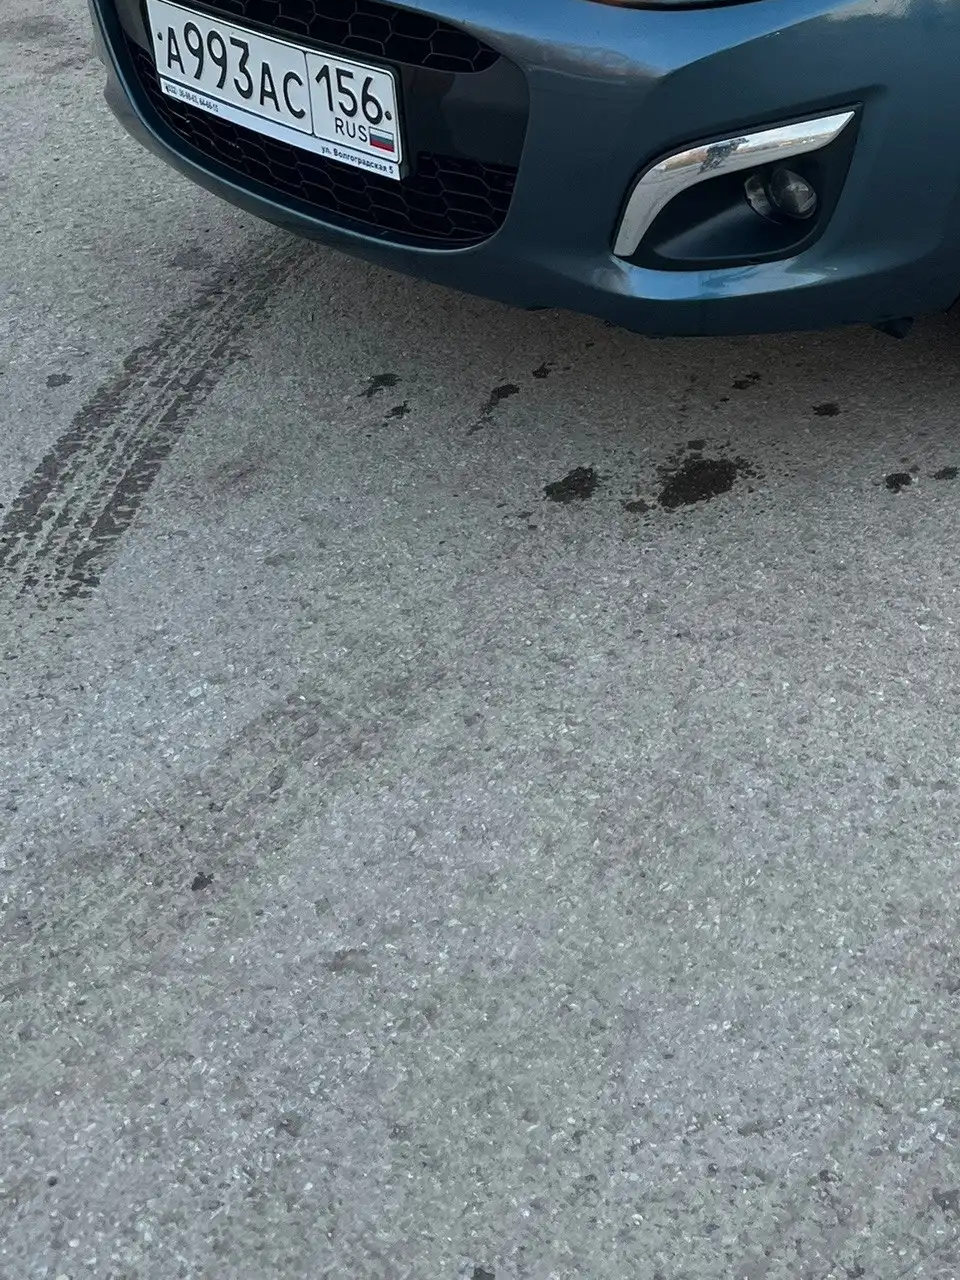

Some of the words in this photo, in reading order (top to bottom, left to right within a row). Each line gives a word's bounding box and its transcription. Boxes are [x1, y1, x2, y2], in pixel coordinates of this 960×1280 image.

[167, 21, 305, 119] А993АС
[315, 64, 382, 125] 156
[335, 117, 368, 142] RUS
